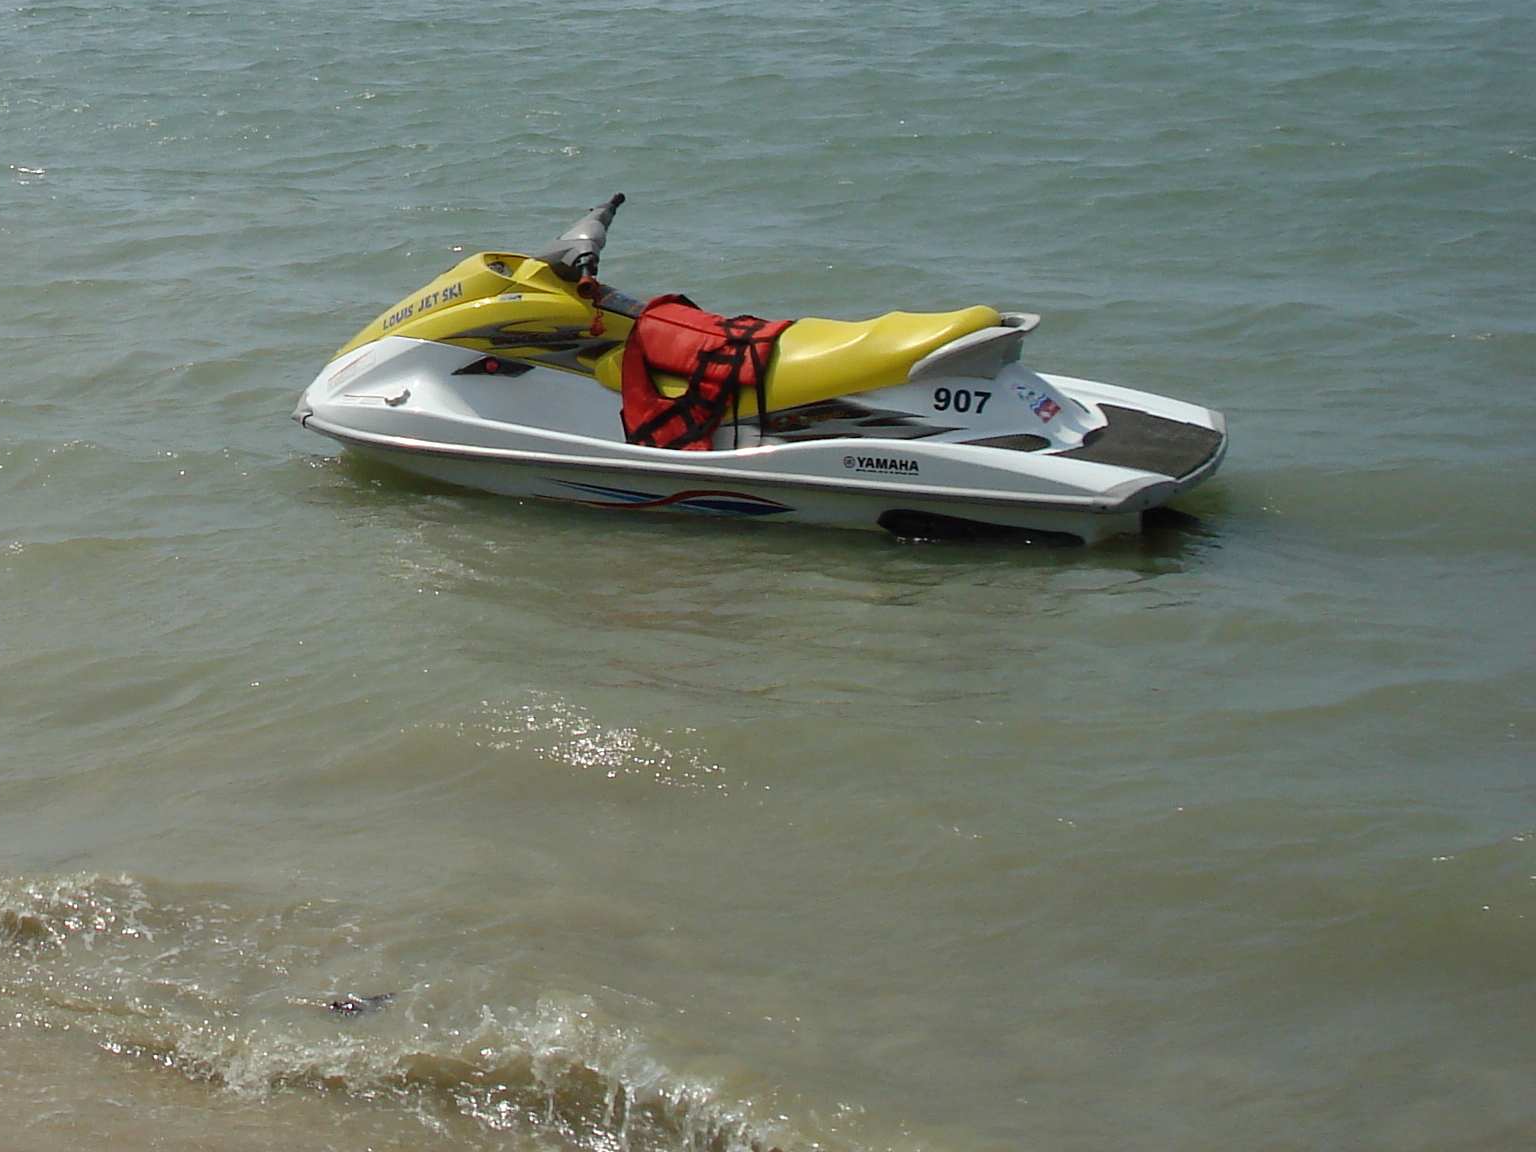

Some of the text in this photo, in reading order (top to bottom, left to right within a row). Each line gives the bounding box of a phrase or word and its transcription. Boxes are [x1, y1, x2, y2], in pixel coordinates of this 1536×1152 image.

[383, 304, 414, 330] LOUIS
[418, 292, 440, 312] JET
[933, 387, 992, 414] 907
[857, 456, 919, 472] YAMAHA
